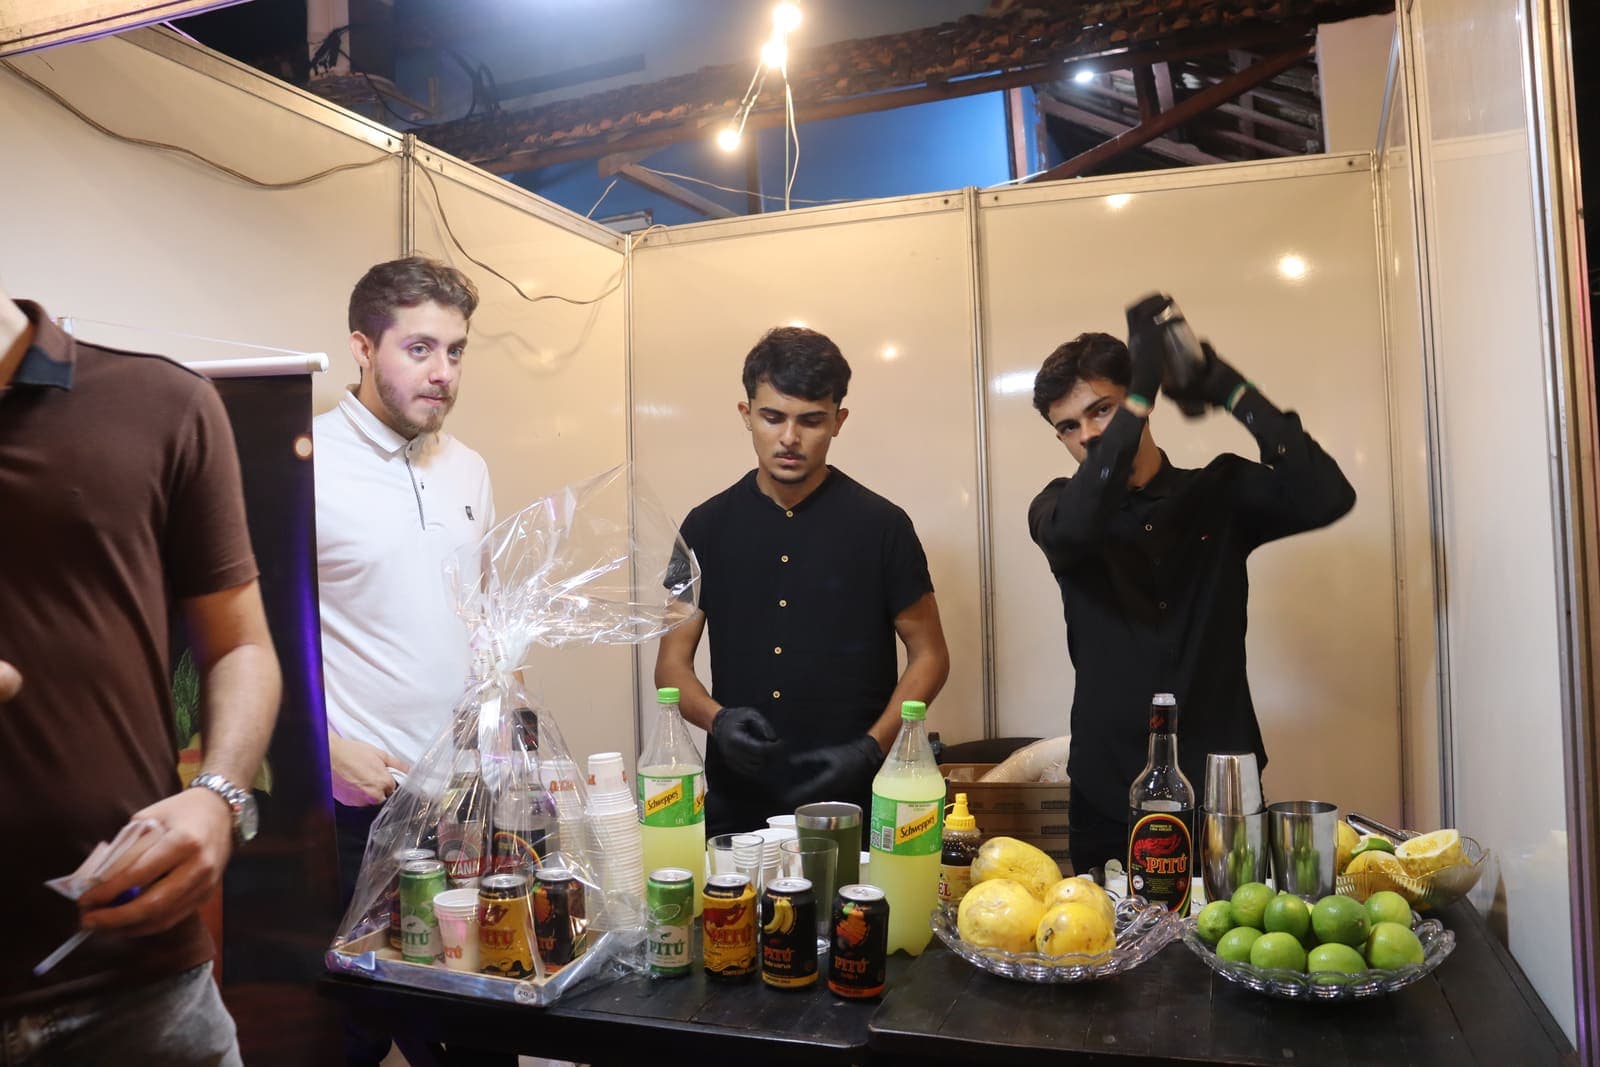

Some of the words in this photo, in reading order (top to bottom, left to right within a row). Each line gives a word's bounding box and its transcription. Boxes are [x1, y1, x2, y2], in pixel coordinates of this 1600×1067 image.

[647, 790, 679, 811] Schweppes
[900, 816, 935, 838] Schweppes
[1146, 852, 1187, 874] PITÚ
[938, 882, 952, 897] EL
[649, 939, 684, 956] PITÚ
[763, 946, 794, 962] PITÚ
[834, 955, 868, 974] PITÚ
